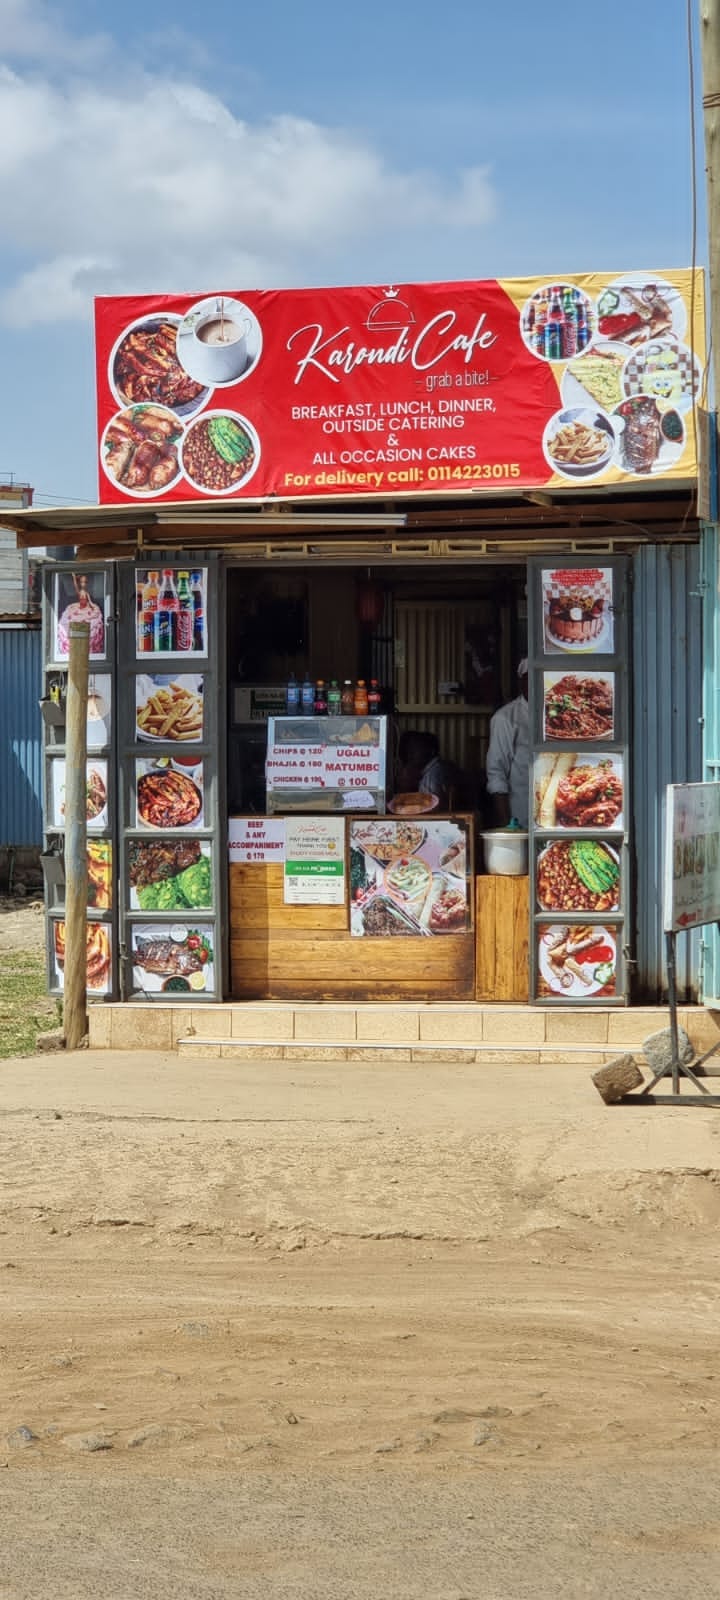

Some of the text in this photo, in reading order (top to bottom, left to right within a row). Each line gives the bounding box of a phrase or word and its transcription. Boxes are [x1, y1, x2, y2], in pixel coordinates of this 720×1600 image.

[287, 323, 411, 384] Karondi
[411, 310, 497, 370] Cafe
[426, 370, 489, 392] grab a bite!
[291, 398, 497, 420] BREAKFAST, LUNCH, DINNER,
[322, 415, 465, 434] OUTSIDE CATERING
[387, 433, 399, 447] &
[312, 445, 476, 465] ALL OCCASION CAKES
[284, 463, 521, 491] For delivery call: 0114223015
[336, 749, 370, 757] UGALI
[266, 760, 297, 768] BHAJIA
[299, 760, 306, 768] @
[303, 776, 310, 784] @
[337, 777, 368, 786] @ 100
[252, 831, 266, 839] ANY
